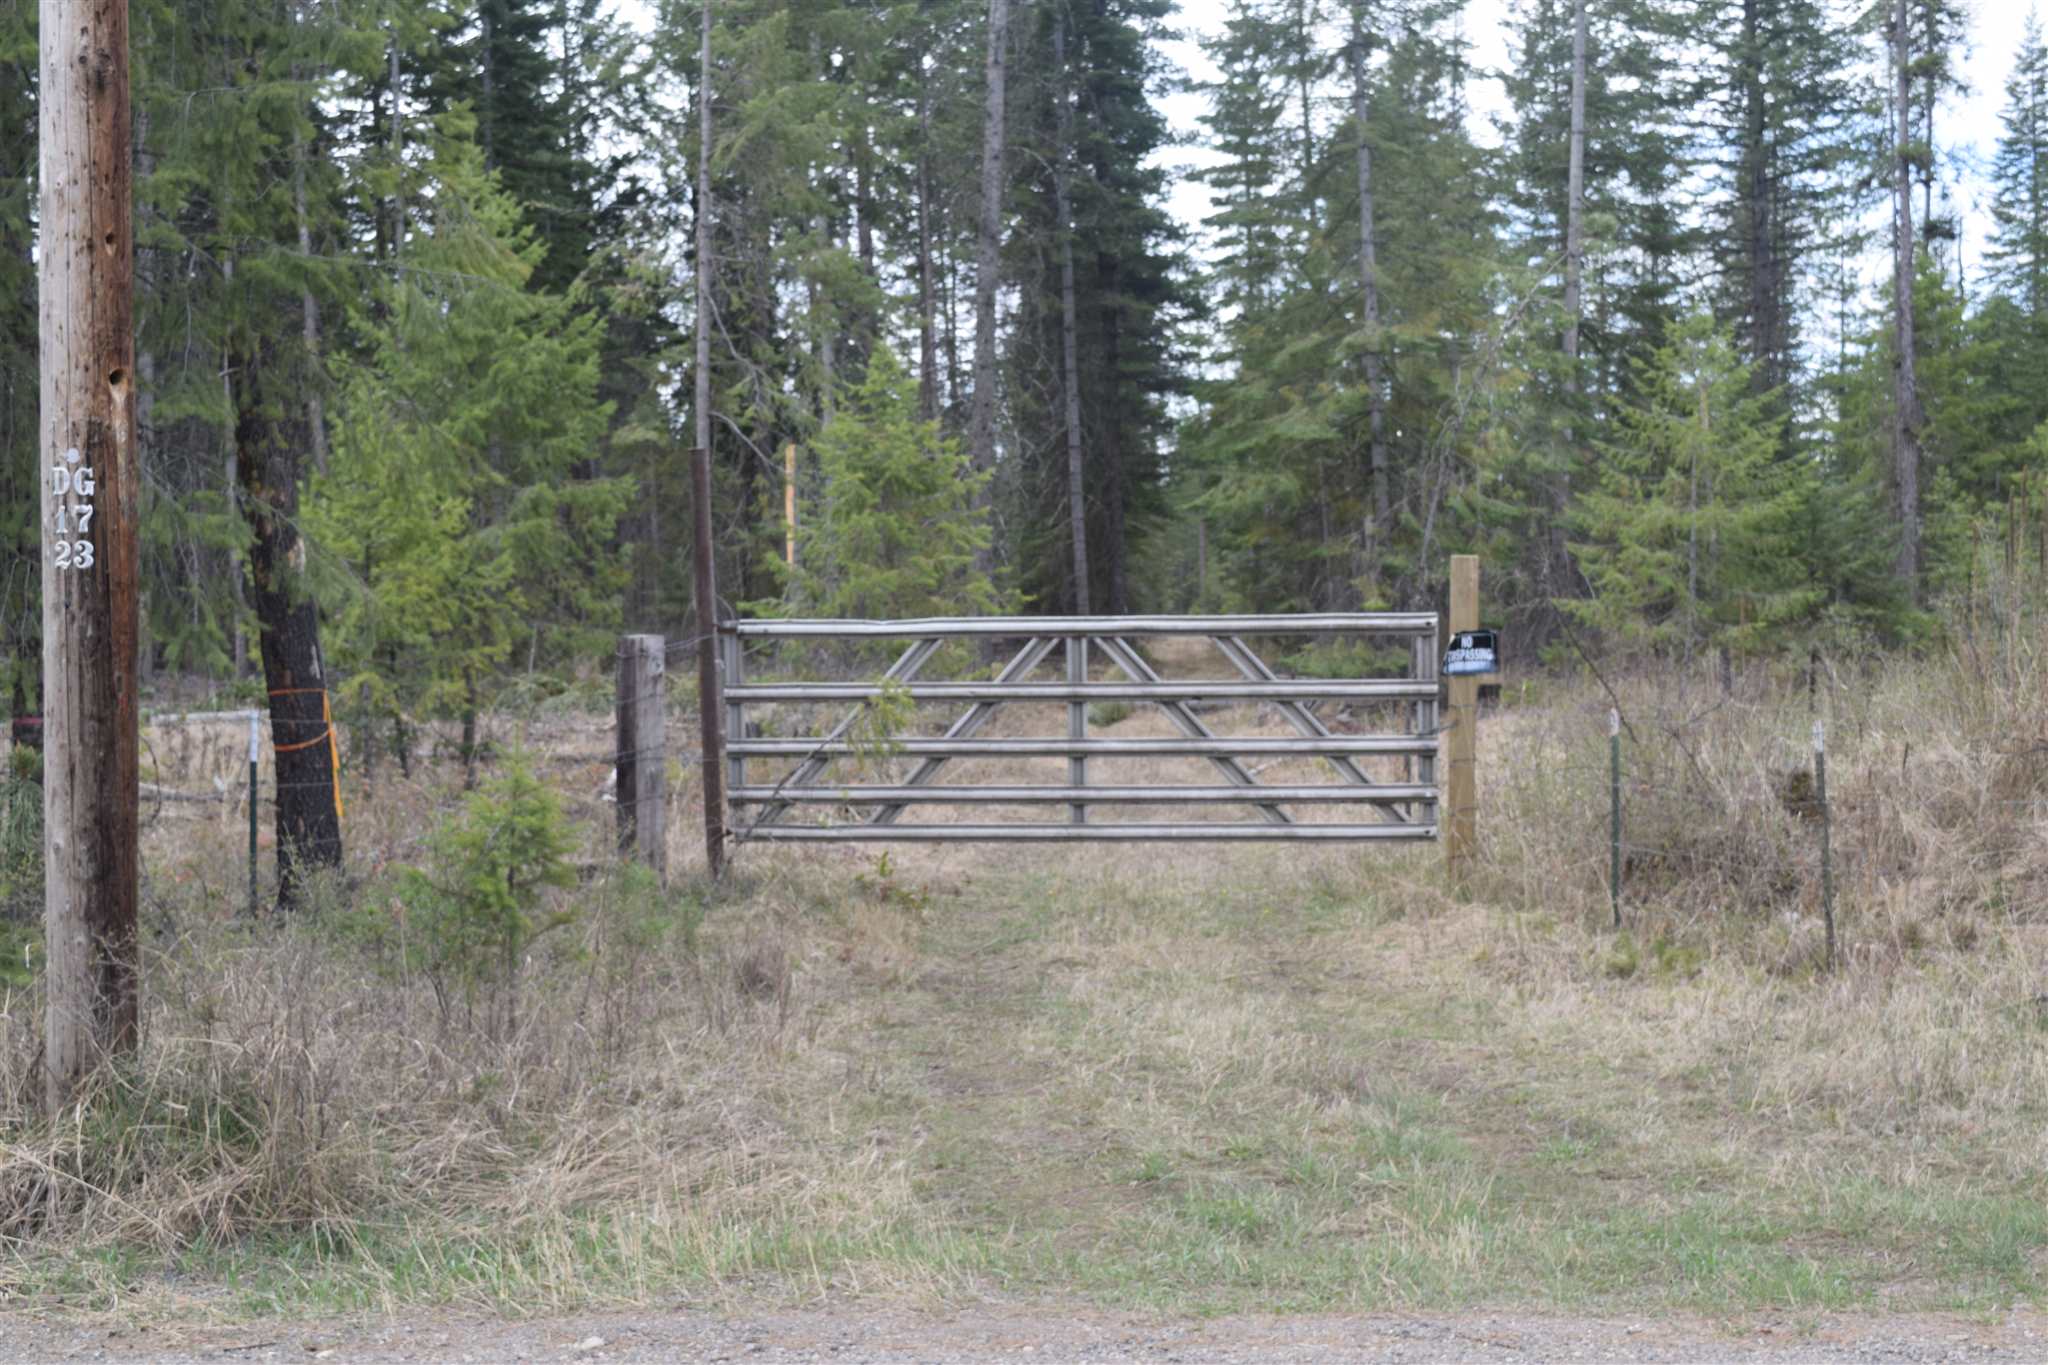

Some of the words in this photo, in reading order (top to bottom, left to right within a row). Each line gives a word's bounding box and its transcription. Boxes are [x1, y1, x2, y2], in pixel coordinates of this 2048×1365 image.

[50, 466, 95, 496] DG
[54, 504, 93, 533] 17
[54, 540, 94, 569] 23
[1461, 634, 1473, 648] NO
